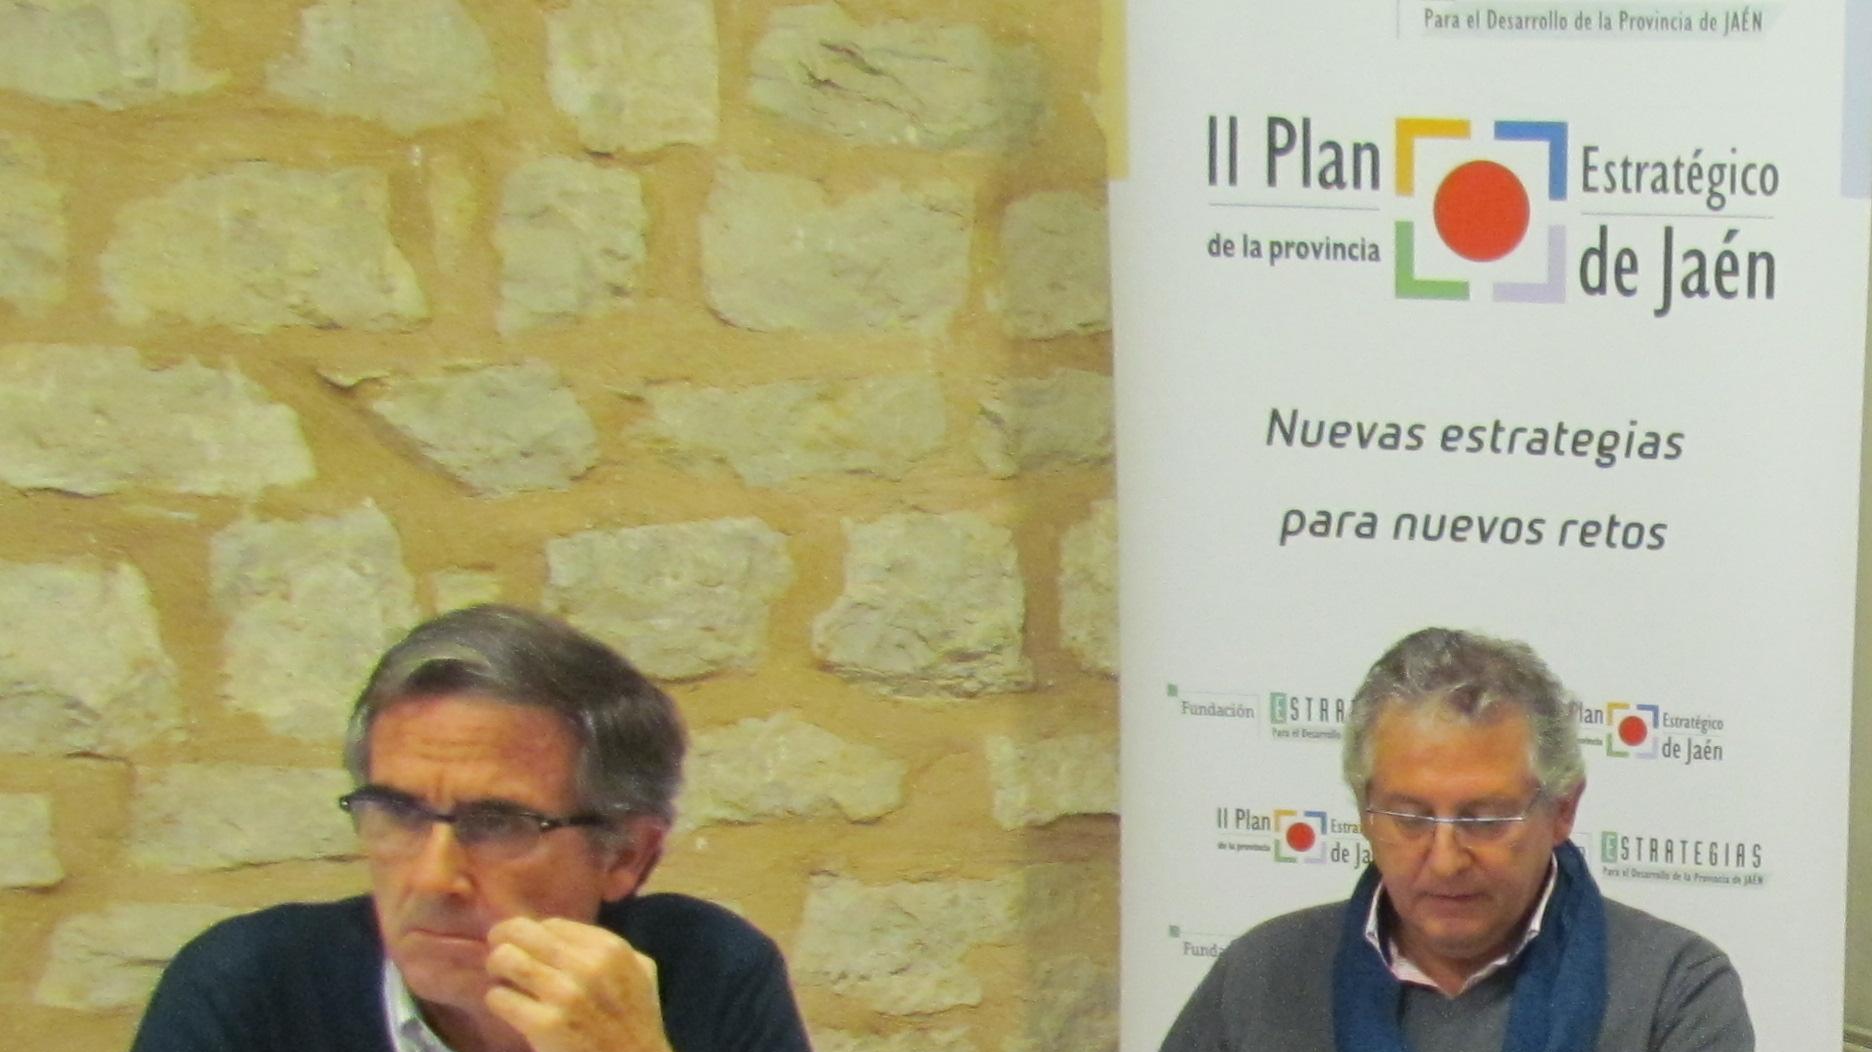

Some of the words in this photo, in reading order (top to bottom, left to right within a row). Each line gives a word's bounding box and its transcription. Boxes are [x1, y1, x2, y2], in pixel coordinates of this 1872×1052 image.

[1424, 8, 1460, 29] Para
[1467, 10, 1480, 29] el
[1487, 9, 1568, 31] Desarrollo
[1574, 11, 1592, 31] de
[1598, 11, 1612, 32] la
[1619, 10, 1693, 32] Provincia
[1700, 11, 1717, 32] de
[1723, 6, 1762, 37] JAÉN
[1208, 115, 1238, 186] II
[1267, 116, 1380, 190] Plan
[1582, 145, 1779, 211] Estratégico
[1207, 233, 1235, 258] de
[1243, 234, 1262, 259] la
[1269, 236, 1381, 267] provincia
[1579, 224, 1639, 297] de
[1653, 226, 1775, 318] Jaén
[1266, 407, 1426, 451] Nuevas
[1440, 419, 1685, 468] estrategias
[1278, 508, 1378, 546] para
[1392, 511, 1546, 545] nuevos
[1558, 514, 1668, 551] retos
[1181, 701, 1255, 719] Fundación
[1271, 694, 1345, 723] ESTRA
[1663, 712, 1724, 734] Estratégico
[1272, 728, 1289, 738] Para
[1292, 729, 1299, 738] el
[1302, 728, 1341, 740] Desarrollo
[1662, 737, 1681, 759] de
[1685, 738, 1723, 765] Jaén
[1217, 807, 1228, 829] II
[1235, 808, 1271, 831] Plan
[1331, 819, 1361, 834] Estra
[1330, 842, 1350, 863] de
[1354, 842, 1371, 869] Ja
[1603, 833, 1762, 868] ESTRATEGIAS
[1602, 867, 1620, 877] Para
[1622, 868, 1629, 878] el
[1631, 869, 1670, 880] Desarrollo
[1672, 871, 1682, 881] de
[1684, 872, 1692, 882] la
[1694, 872, 1730, 884] Provincia
[1732, 875, 1741, 884] de
[1744, 872, 1763, 887] JAÉN
